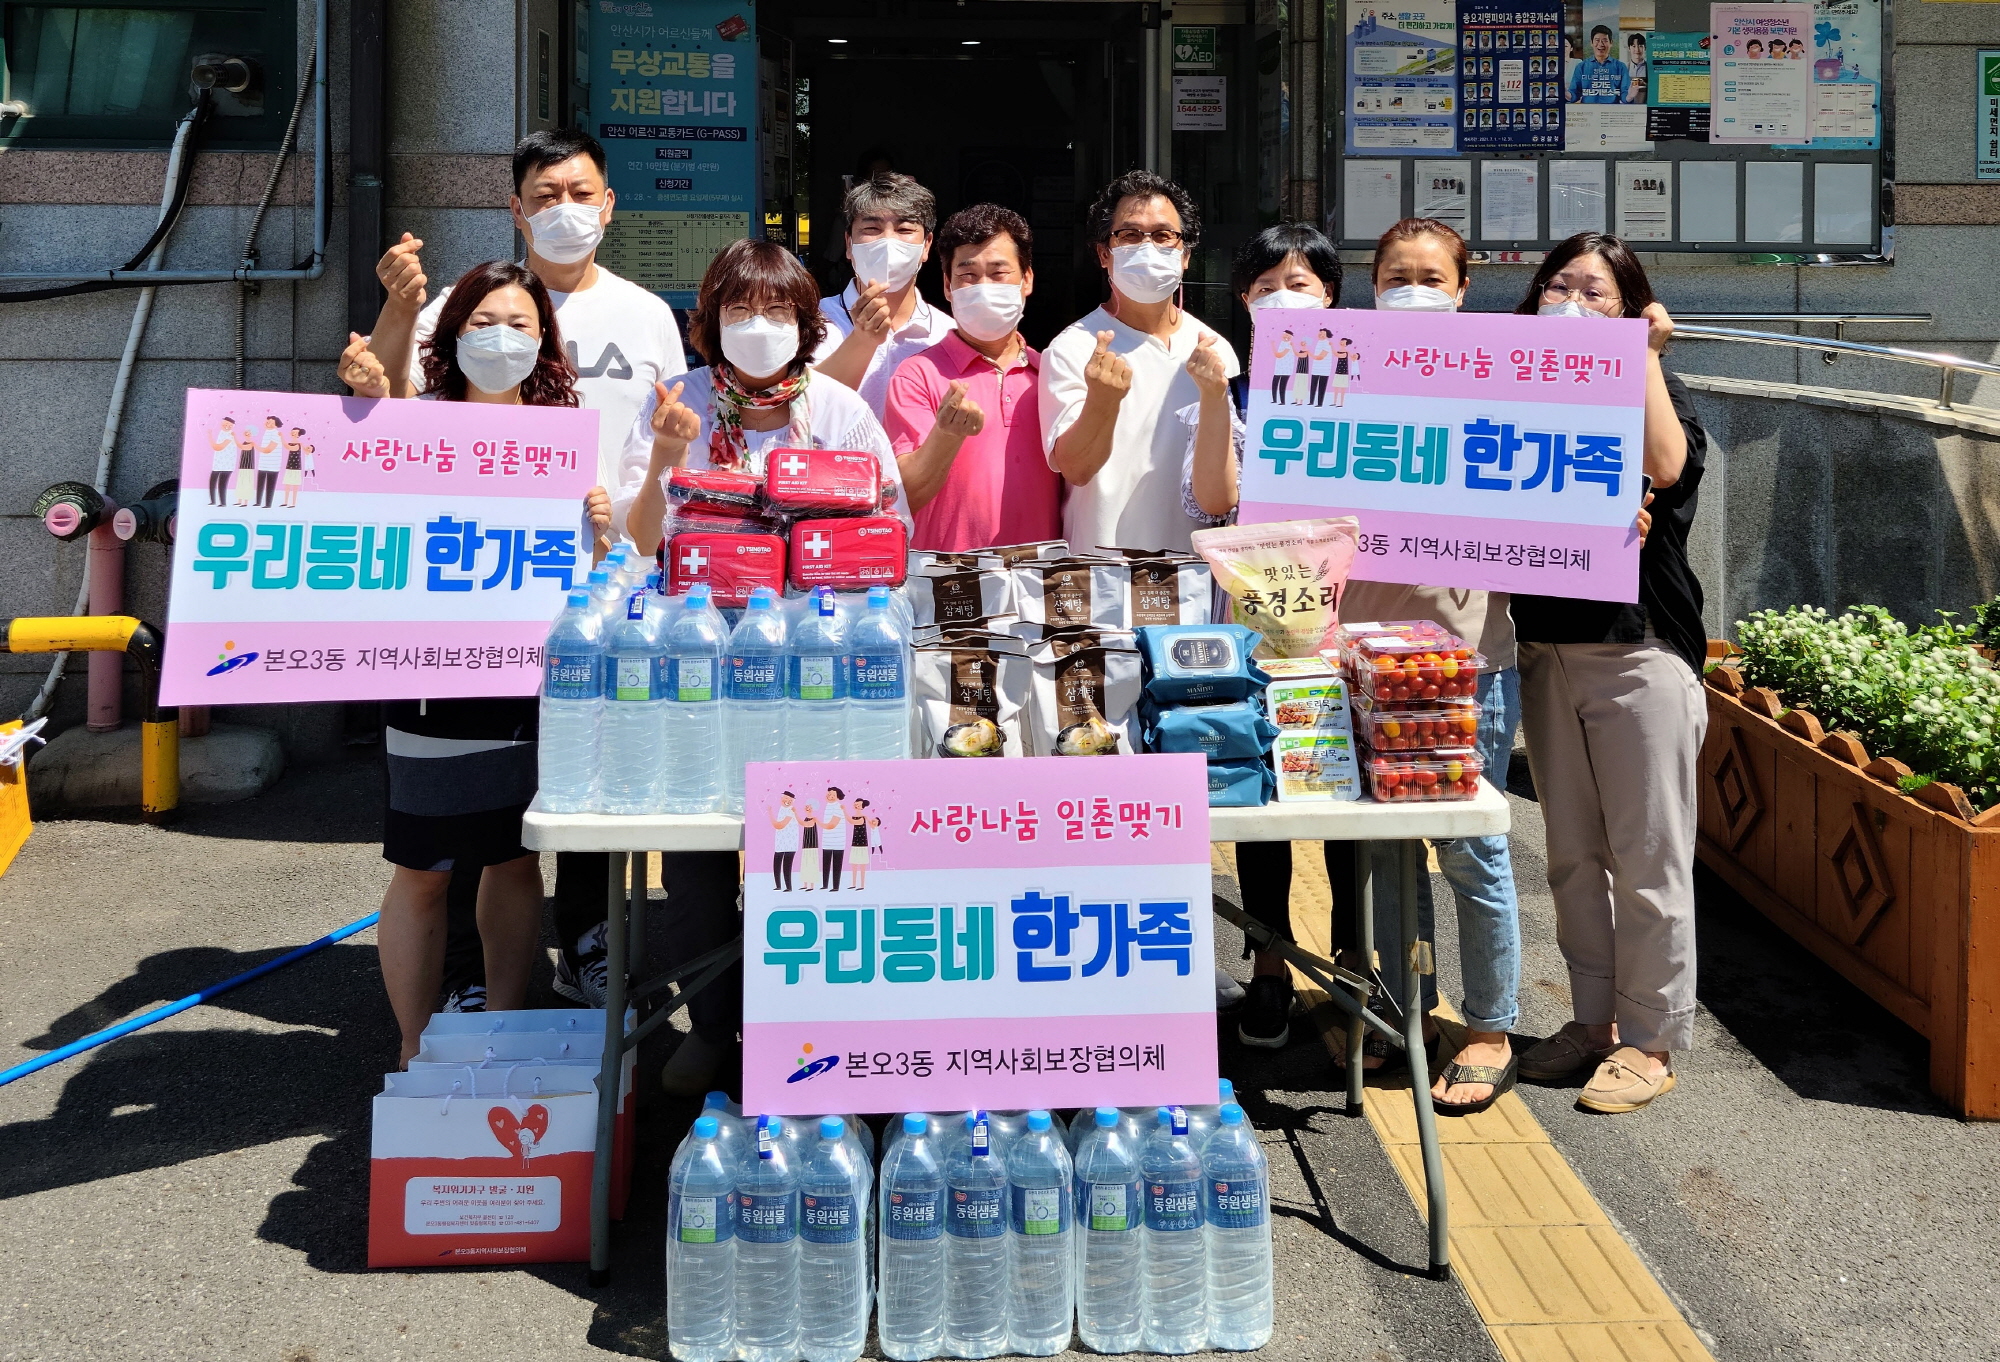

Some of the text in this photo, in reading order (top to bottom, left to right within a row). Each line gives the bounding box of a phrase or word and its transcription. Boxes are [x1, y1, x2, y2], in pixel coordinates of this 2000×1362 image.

[1381, 12, 1425, 20] 주소, 생활 곳곳
[1462, 12, 1558, 24] 중요지명피의자 종합공개수배
[1733, 18, 1790, 26] 안산시 여성청소년
[610, 24, 713, 41] 안산시가 어르신들께
[1405, 22, 1432, 30] 편리하고
[1432, 22, 1455, 30] 가깝게!
[1741, 26, 1769, 35] 생리용품
[1769, 26, 1798, 35] 보편지원
[610, 49, 736, 79] 무상교통을
[1190, 51, 1213, 62] AED
[1506, 80, 1521, 89] 112
[1582, 88, 1621, 96] 청년기본소득
[610, 88, 737, 117] 지원합니다
[1176, 105, 1223, 113] 1644-8295
[1989, 98, 1999, 137] 미세먼지
[607, 126, 741, 140] 안산 어르신 교통카드 (G-PASS)
[659, 149, 689, 158] 지원금액
[1989, 139, 1999, 158] 쉼터
[627, 162, 643, 171] 연간
[697, 163, 720, 172] 4만원)
[659, 179, 689, 189] 신청기간
[730, 194, 743, 202] 실시
[566, 340, 633, 380] LA
[1384, 347, 1623, 385] 사랑나눔 일촌맺기
[340, 438, 577, 477] 사랑나눔 일촌맺기
[1258, 418, 1624, 497] 우리동네 한가족
[193, 515, 577, 591] 우리동네 한가족
[1357, 533, 1592, 572] 3동 지역사회보장협의체
[1263, 565, 1312, 584] 맛있는
[1053, 599, 1083, 613] 삼계탕
[1140, 596, 1171, 610] 삼계탕
[1239, 582, 1339, 617] 풍경소리
[943, 605, 974, 617] 삼계탕
[263, 645, 545, 672] 본오3동 지역사회보장협의체
[551, 668, 592, 682] 동원샘물
[734, 669, 775, 683] 동원샘물
[857, 668, 898, 683] 동원샘물
[960, 688, 993, 703] 삼계탕
[1065, 686, 1096, 702] 삼계탕
[1187, 686, 1213, 694] MAMIYO
[1298, 699, 1331, 710] 도토리묵
[1303, 749, 1337, 758] 도토리묵
[910, 797, 1182, 843] 사랑나눔 일촌맺기
[763, 891, 1193, 985] 우리동네 한가족
[845, 1044, 1166, 1079] 본오3동 지역사회보장협의체
[433, 1185, 535, 1195] 복지위기가구 발굴 지원
[1154, 1196, 1197, 1212] 동원샘물
[1217, 1194, 1261, 1210] 동원샘물
[742, 1209, 786, 1224] 동원샘물
[806, 1209, 850, 1224] 동원샘물
[892, 1206, 936, 1221] 동원샘물
[956, 1204, 1000, 1219] 동원샘물
[455, 1246, 527, 1255] 본오3동지역사회보장협의체
